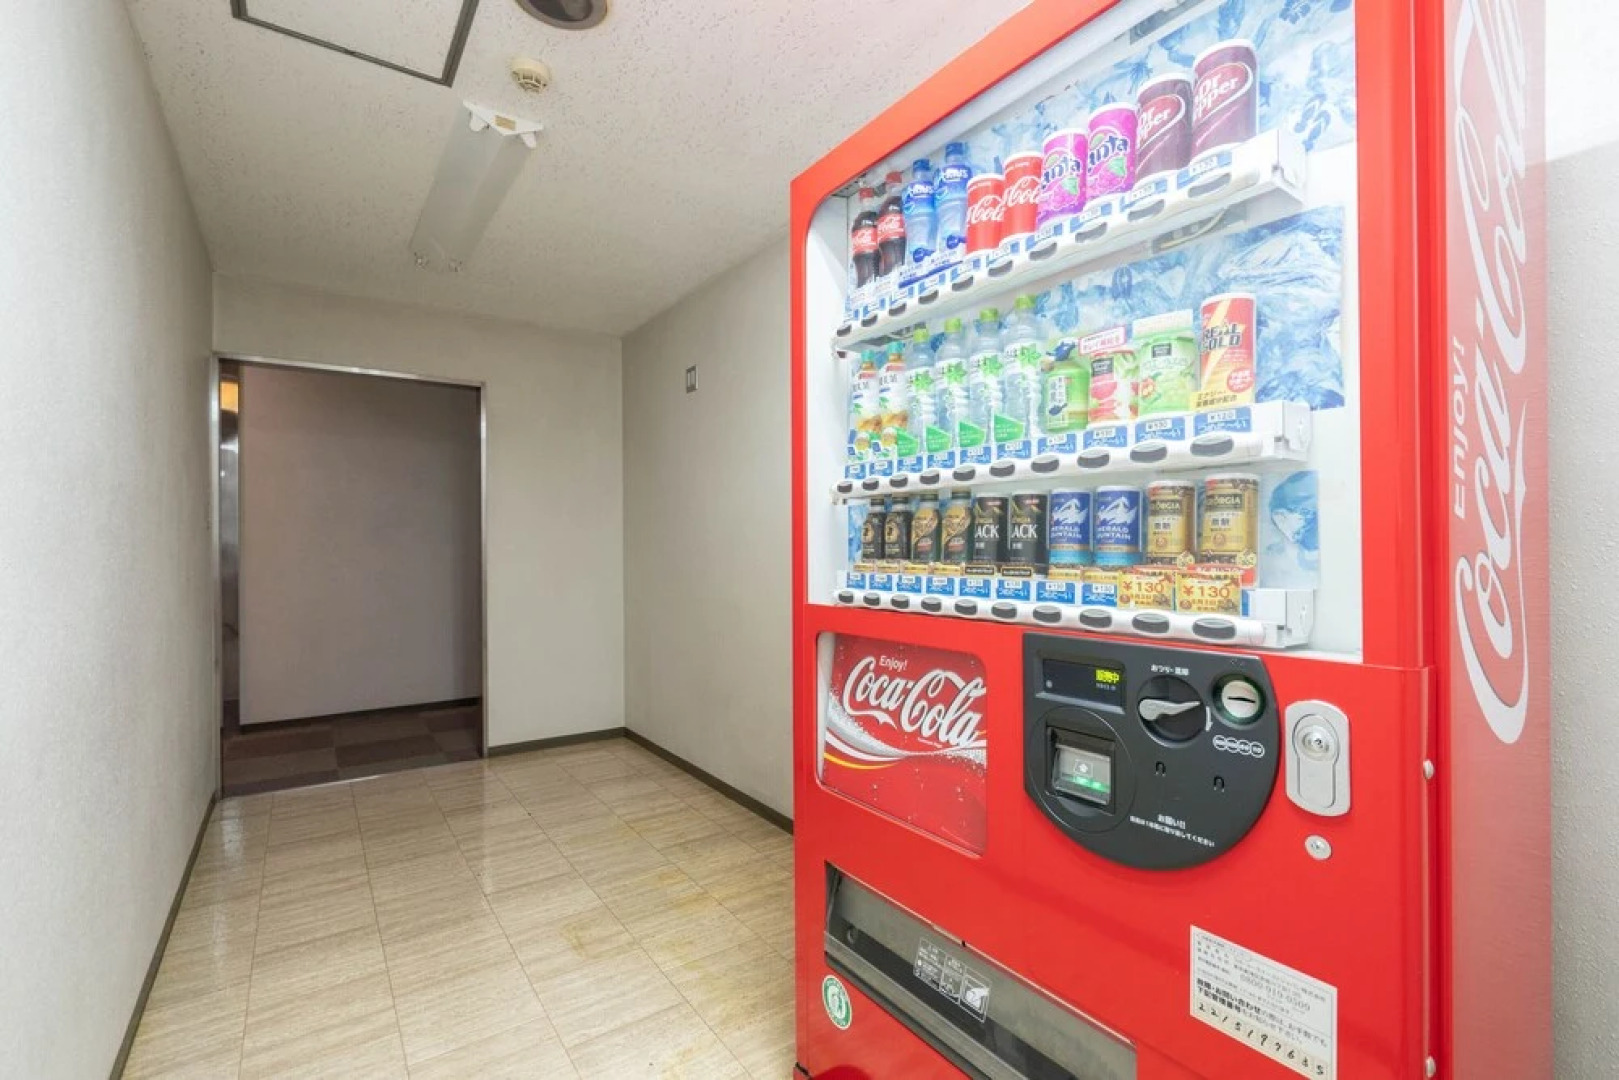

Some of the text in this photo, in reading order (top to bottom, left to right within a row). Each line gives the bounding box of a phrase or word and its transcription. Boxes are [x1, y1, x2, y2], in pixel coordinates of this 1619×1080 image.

[1453, 336, 1468, 521] Enjoy!
[1123, 580, 1165, 594] ¥130
[1182, 585, 1231, 599] ¥130
[879, 655, 908, 672] Enjoy!
[842, 656, 987, 747] Coca-Cola
